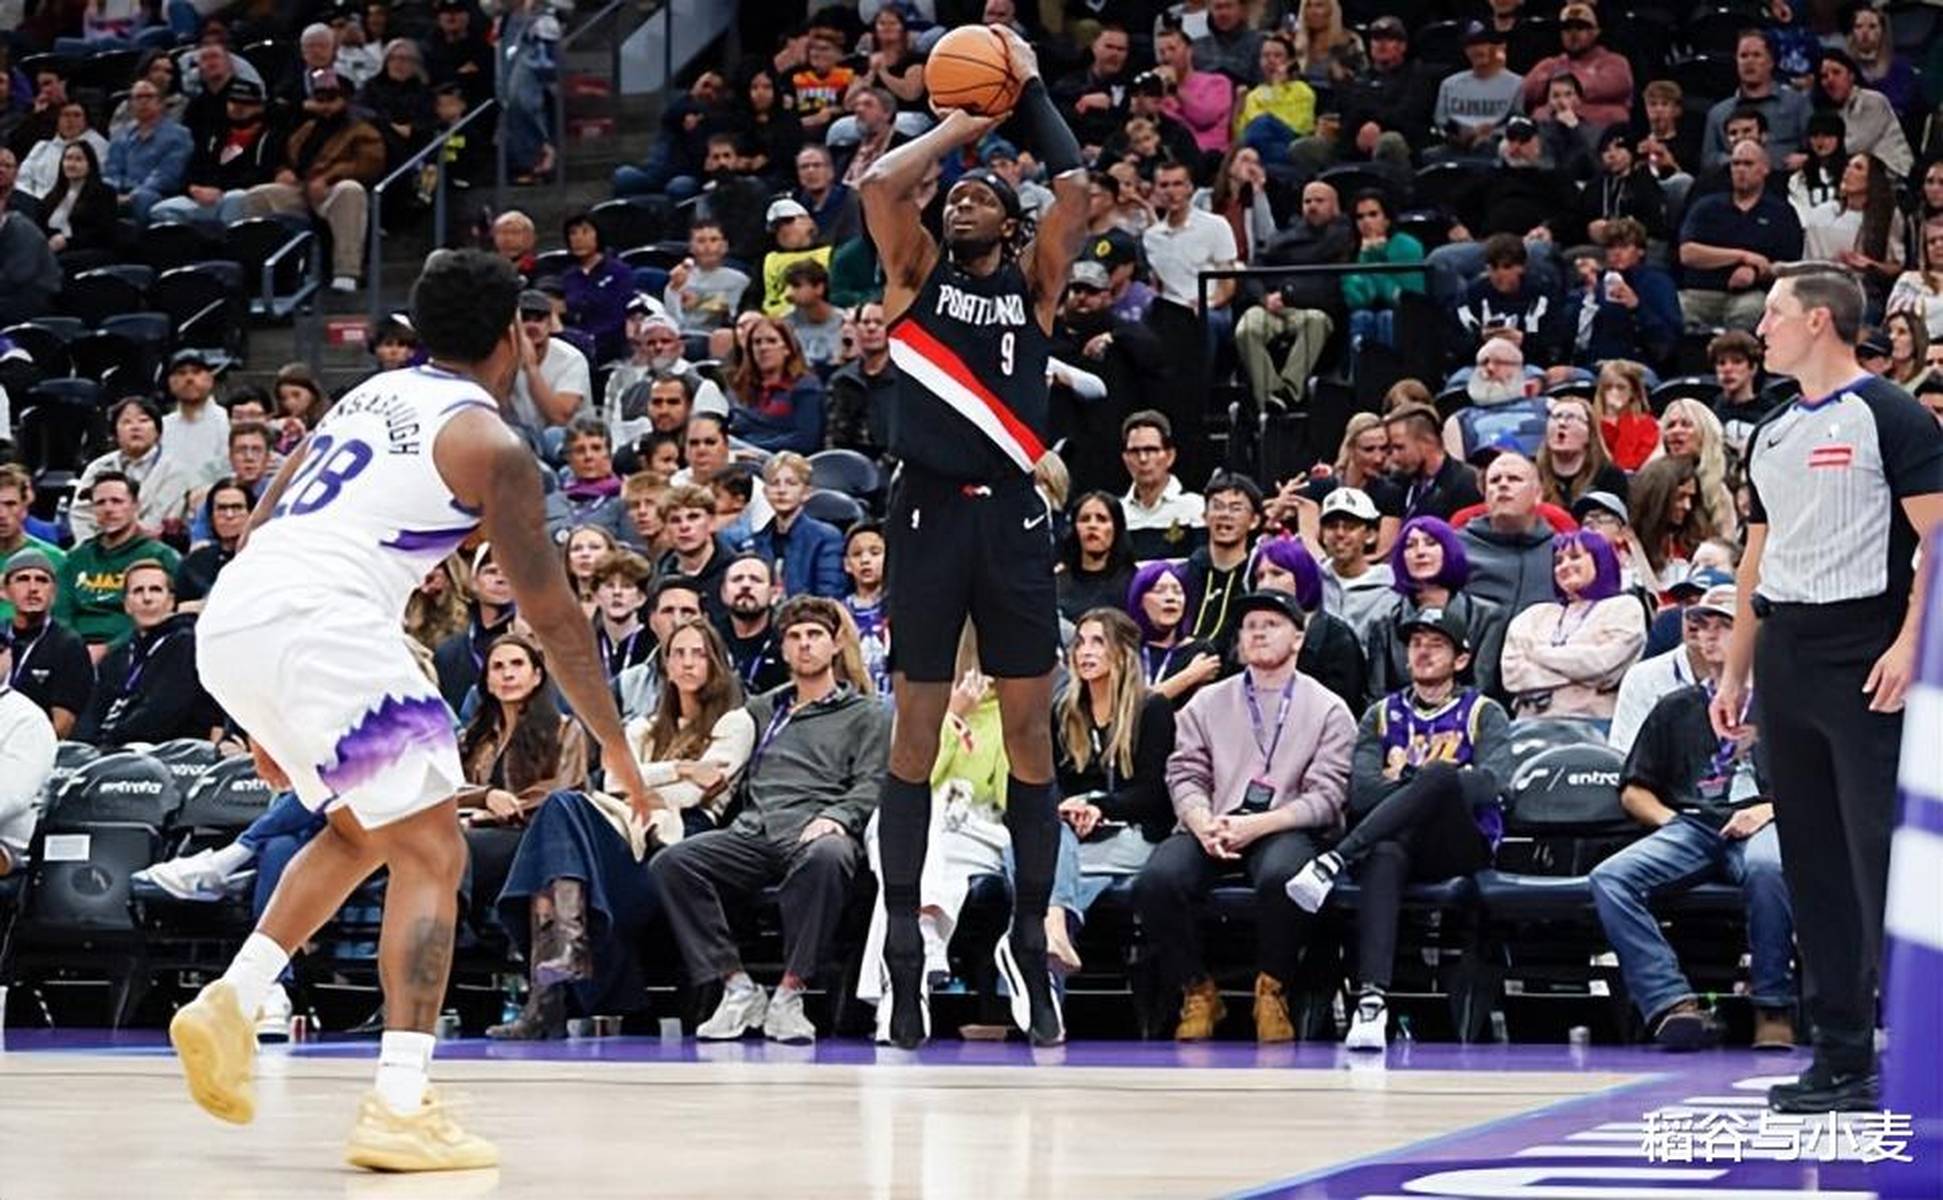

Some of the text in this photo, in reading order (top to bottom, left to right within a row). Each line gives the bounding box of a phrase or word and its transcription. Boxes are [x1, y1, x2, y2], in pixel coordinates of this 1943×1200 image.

[936, 284, 1027, 326] PORTLAND
[1001, 331, 1015, 376] 9
[272, 433, 374, 516] 28
[231, 777, 272, 792] entr
[1567, 769, 1620, 787] entra
